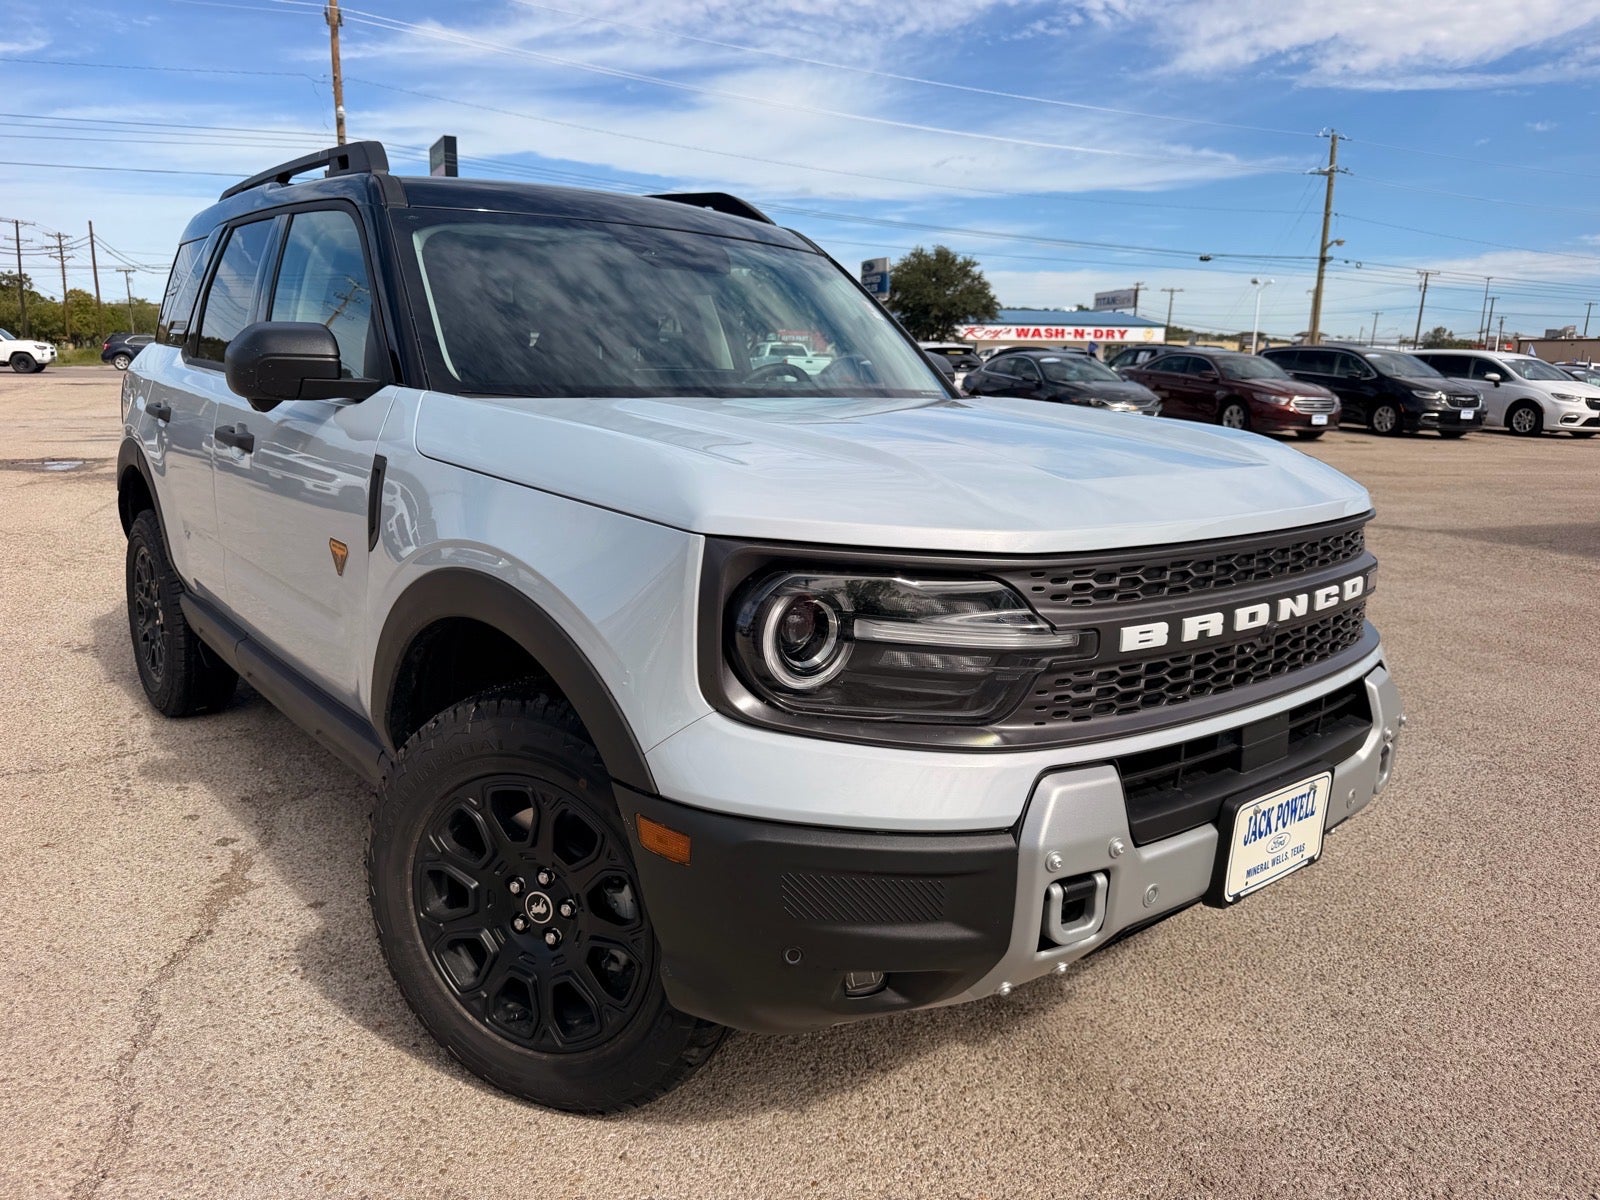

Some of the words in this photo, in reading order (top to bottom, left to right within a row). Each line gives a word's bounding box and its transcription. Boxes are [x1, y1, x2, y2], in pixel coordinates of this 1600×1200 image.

[962, 326, 1011, 340] Roy's
[1015, 327, 1128, 340] WASH-N-DRY
[1119, 575, 1364, 653] BRONCO
[1243, 806, 1275, 847] JACK
[1274, 789, 1318, 833] POWELL
[1246, 860, 1270, 879] MINERAL
[1291, 842, 1306, 858] TEXAS
[1269, 834, 1288, 851] Ford
